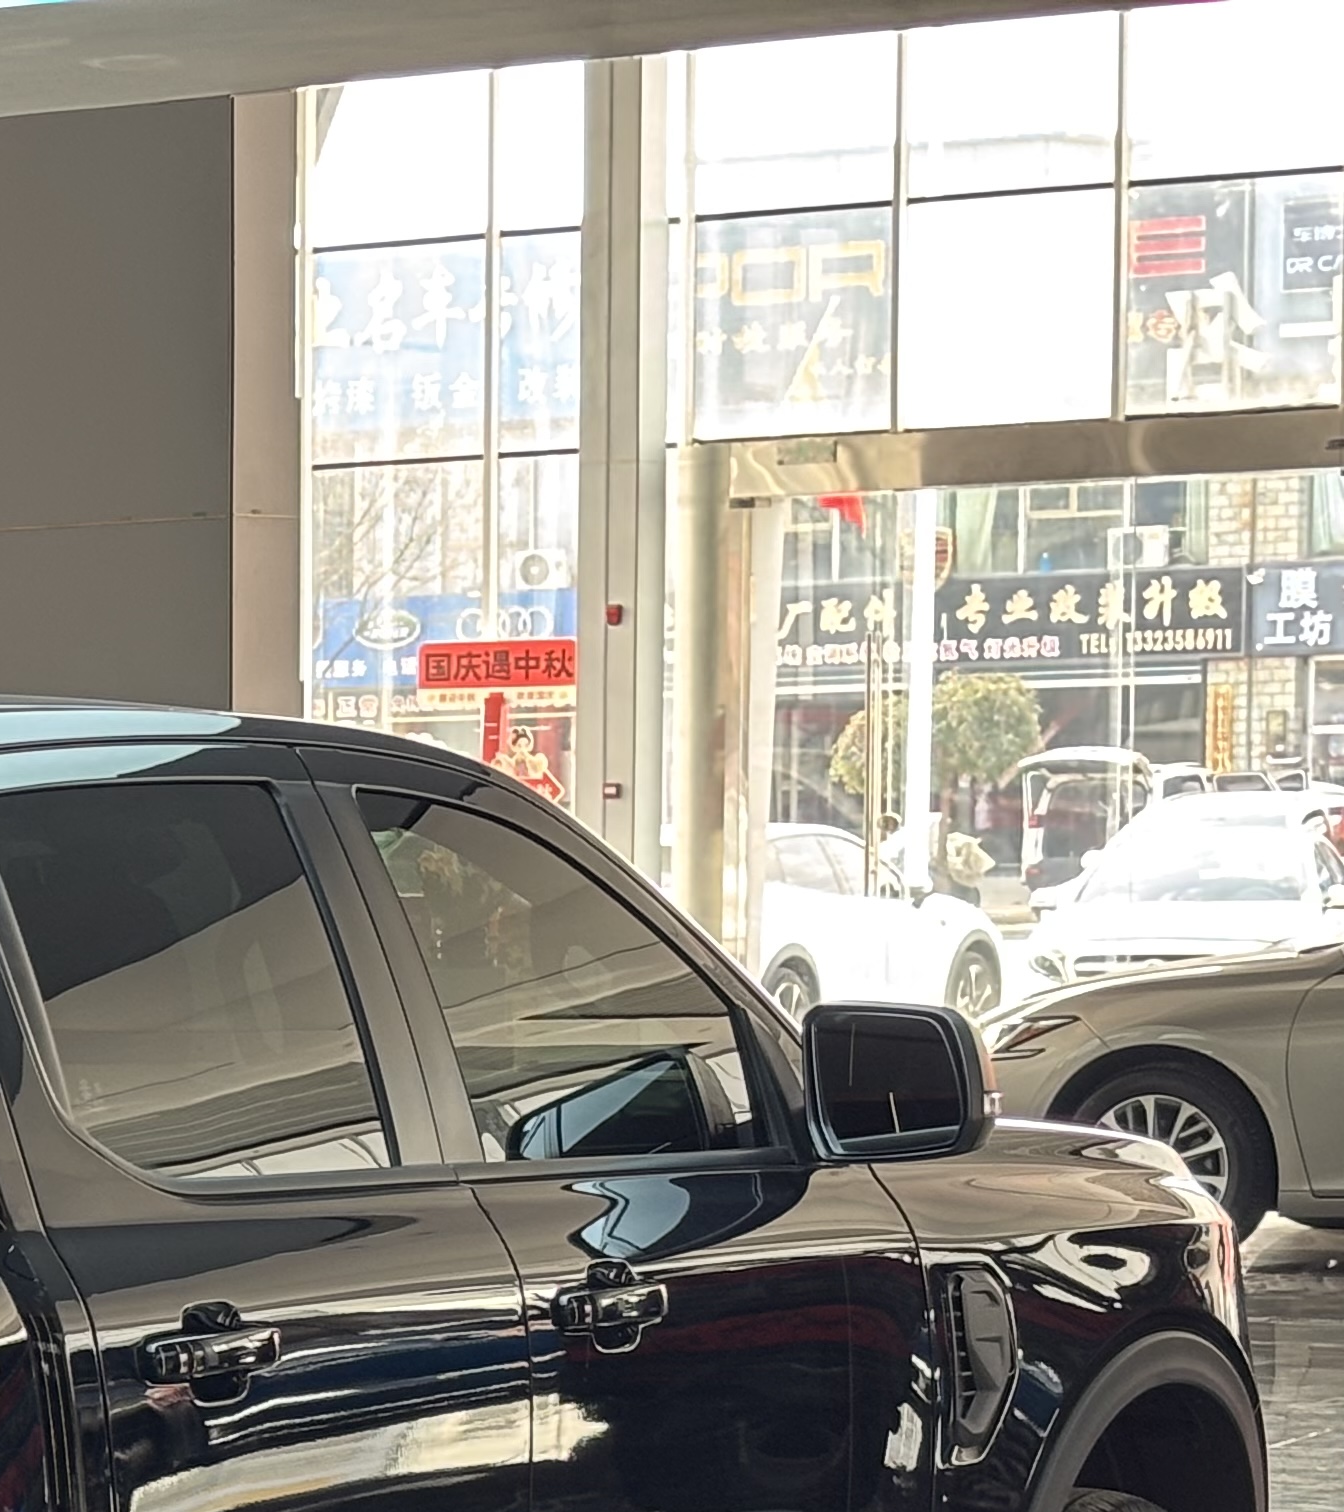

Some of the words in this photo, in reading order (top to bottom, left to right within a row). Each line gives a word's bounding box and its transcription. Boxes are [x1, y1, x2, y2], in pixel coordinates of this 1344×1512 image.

[955, 575, 1228, 631] 专业改装升级
[1264, 609, 1333, 647] 工坊
[424, 648, 575, 682] 国庆遇中秋
